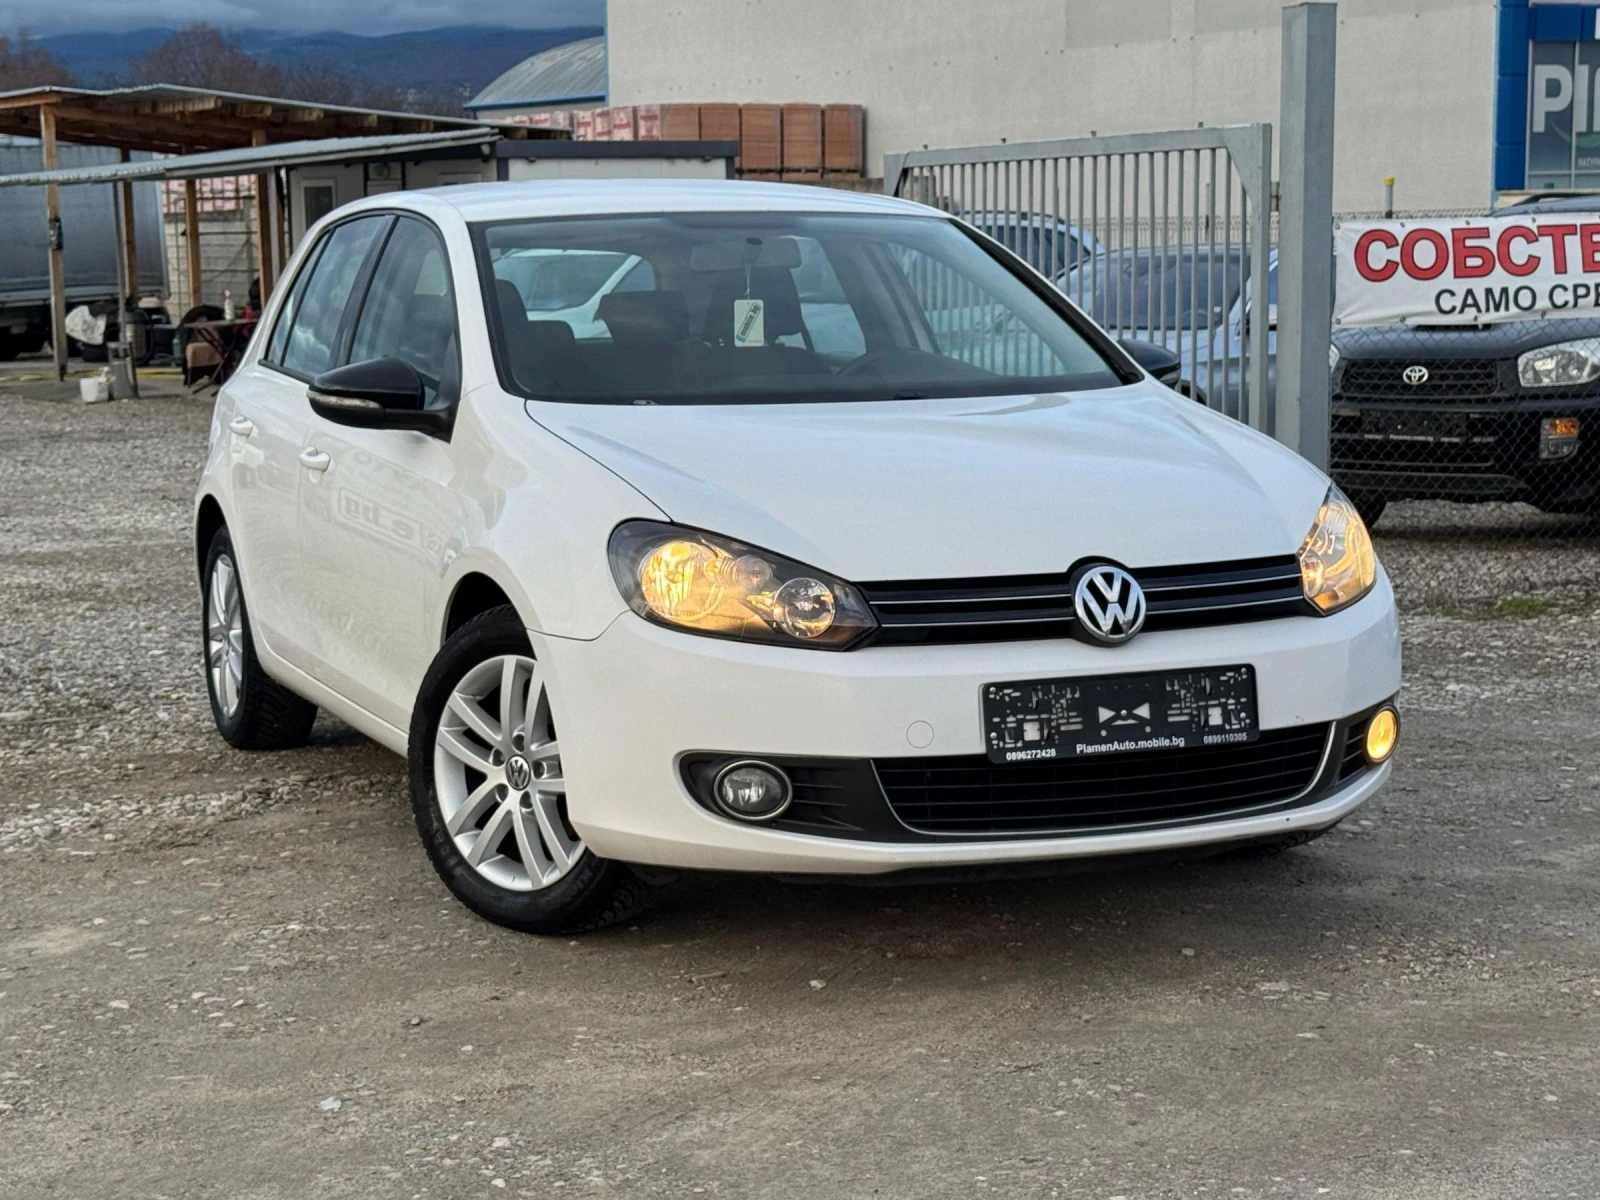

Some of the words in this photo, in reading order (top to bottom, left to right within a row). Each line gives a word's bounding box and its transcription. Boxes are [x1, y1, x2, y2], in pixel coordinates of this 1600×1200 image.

[1533, 64, 1600, 134] PI
[1435, 285, 1537, 314] САМО
[1548, 283, 1600, 309] СР
[1077, 568, 1144, 640] VW
[1006, 748, 1057, 761] 0896272428
[1076, 736, 1185, 754] PlamenAuto.mobile.bg
[507, 757, 529, 789] VW
